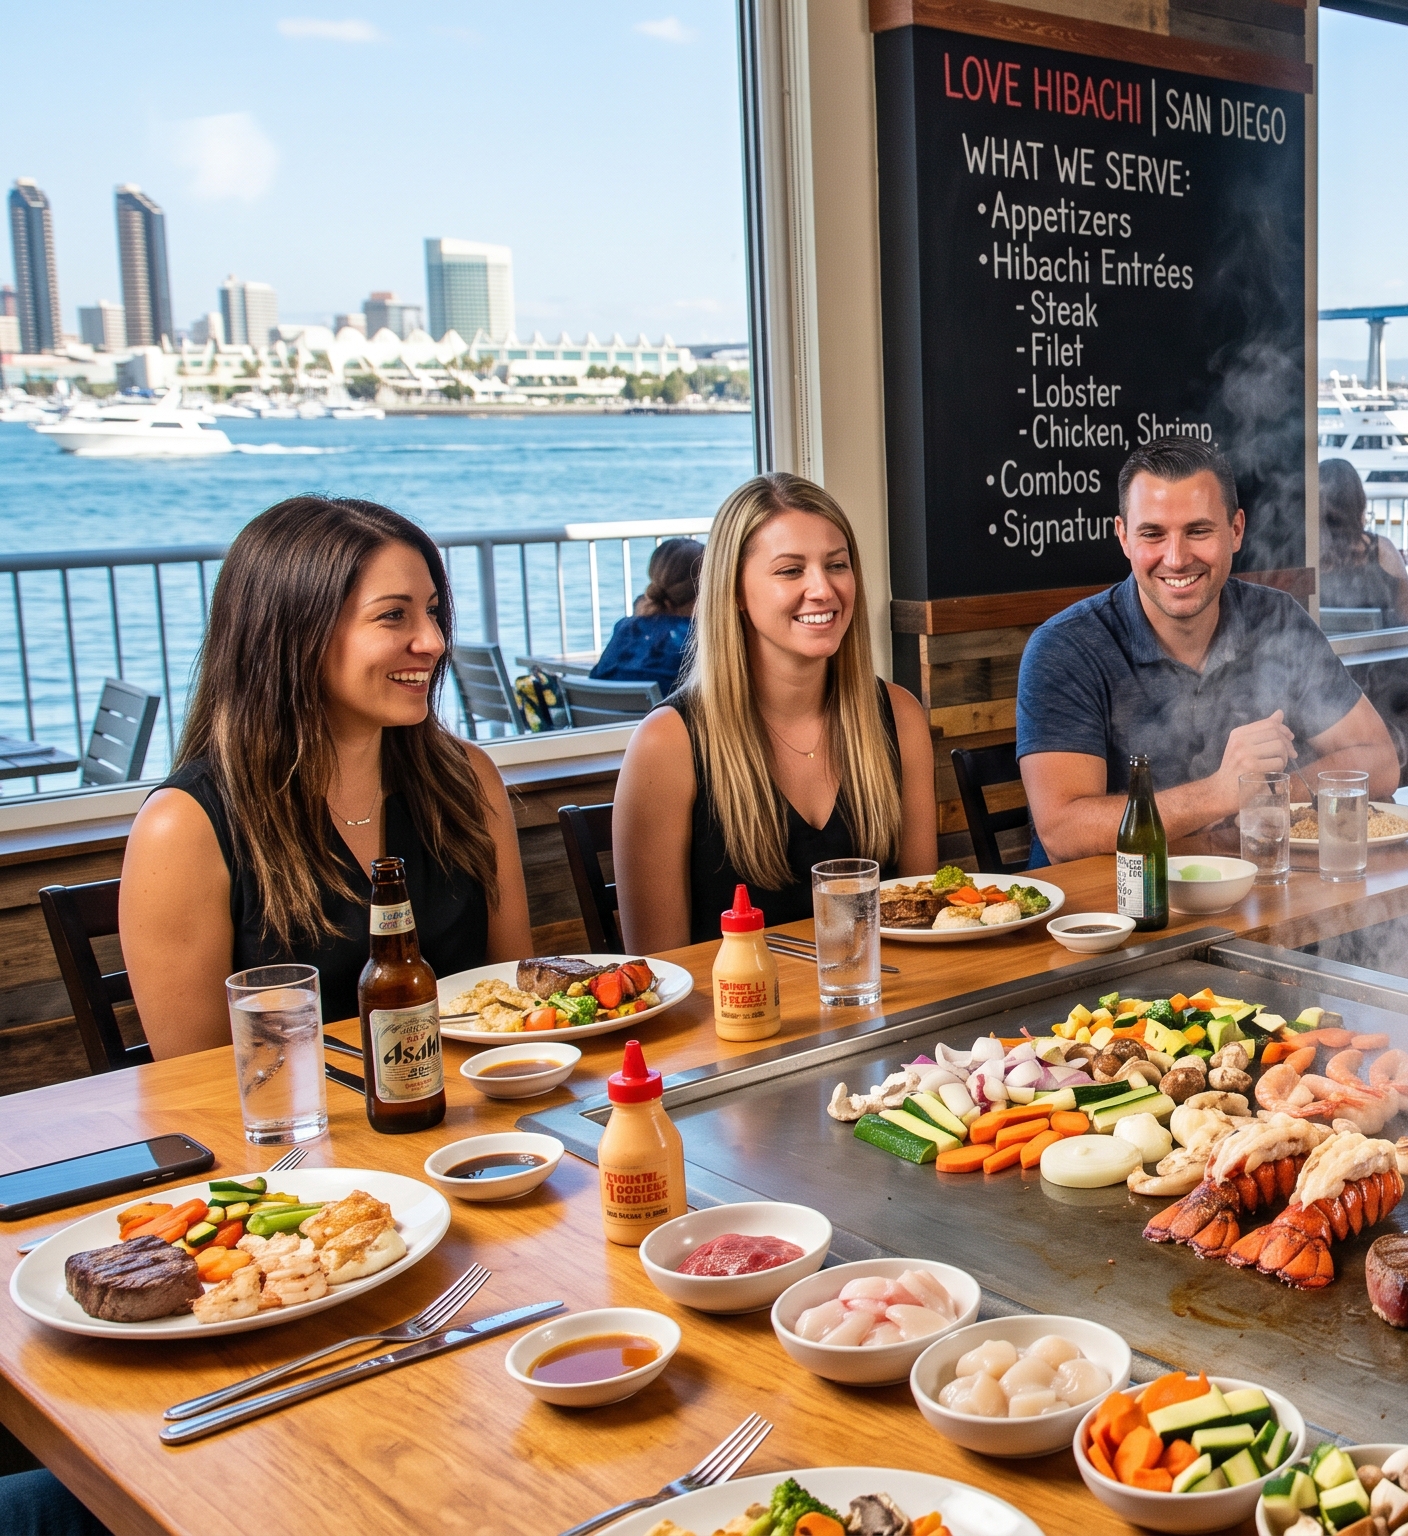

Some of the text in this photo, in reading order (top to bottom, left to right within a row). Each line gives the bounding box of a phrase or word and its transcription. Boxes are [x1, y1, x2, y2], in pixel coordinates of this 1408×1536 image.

[944, 52, 1022, 107] LOVE
[1034, 67, 1141, 124] HIBACHI
[1165, 88, 1211, 134] SAN
[1221, 98, 1287, 145] DIEGO
[961, 132, 1190, 197] WHAT WE SERVE:
[991, 190, 1132, 242] Appetizers
[993, 241, 1193, 290] Hibachi Entrées
[1000, 459, 1101, 498] Combos
[1003, 507, 1118, 557] Signatur
